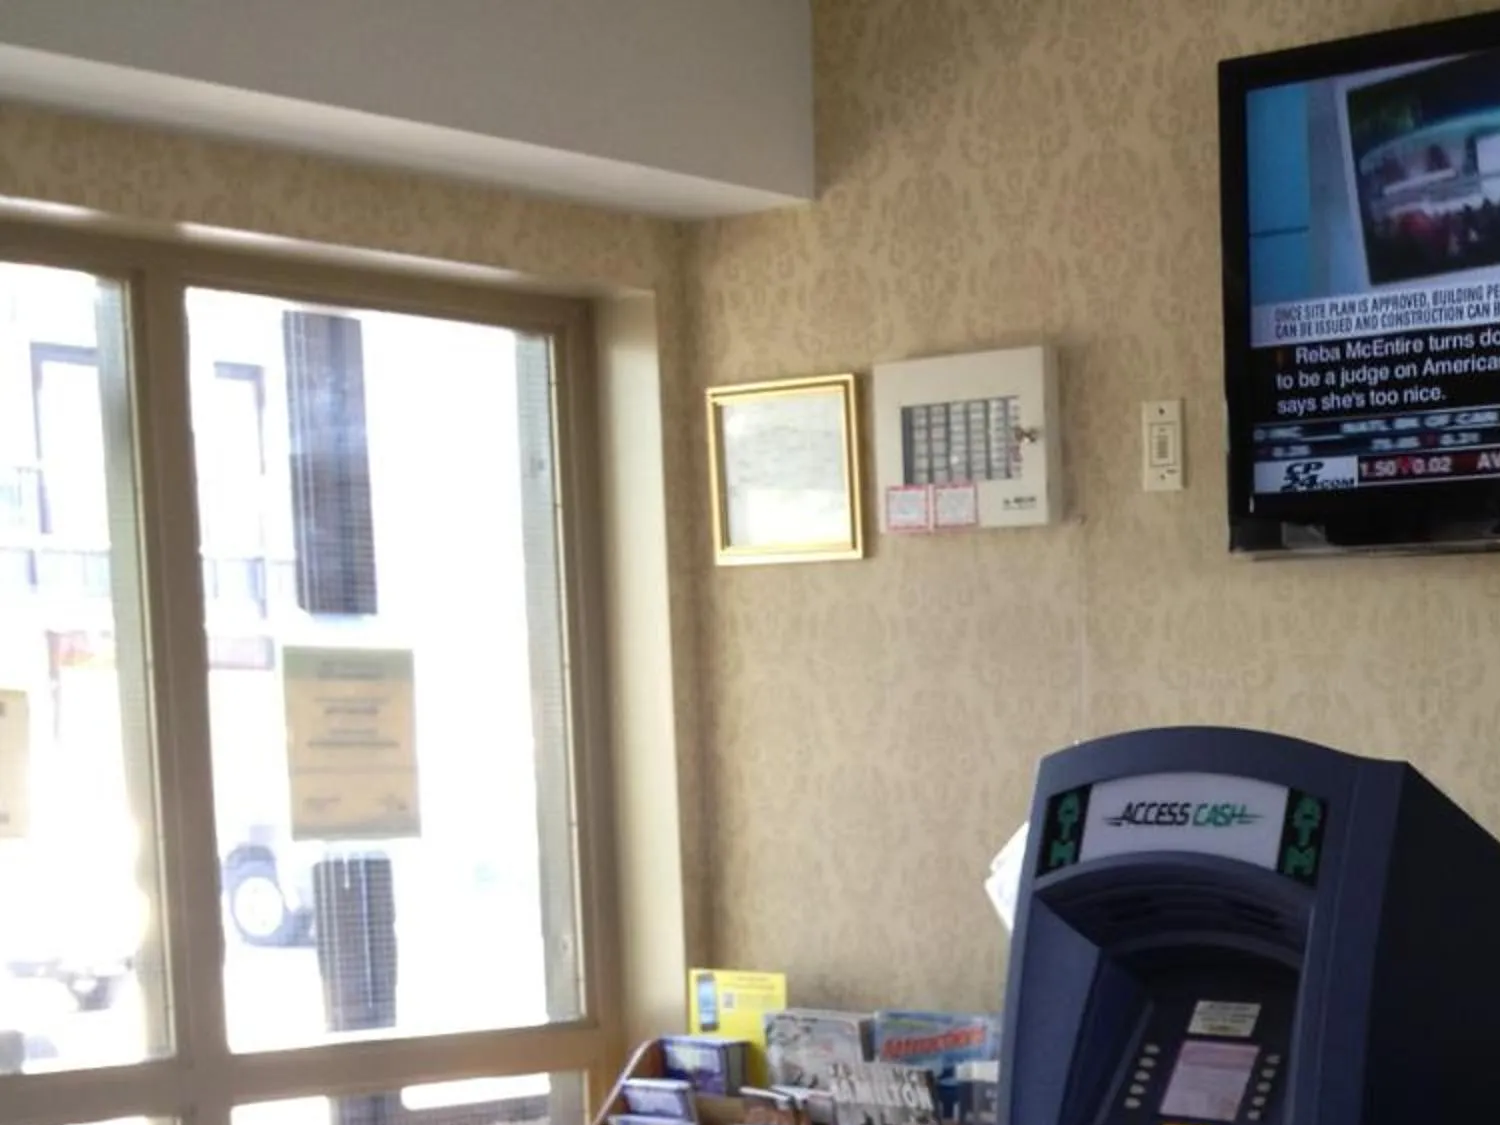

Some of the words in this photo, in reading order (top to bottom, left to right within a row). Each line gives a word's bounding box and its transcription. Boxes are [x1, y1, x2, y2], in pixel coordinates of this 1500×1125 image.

[1304, 302, 1326, 319] SITE
[1329, 299, 1356, 318] PLAN
[1358, 298, 1370, 314] IS
[1432, 285, 1484, 306] BUILDING
[1275, 321, 1297, 338] CAN
[1300, 320, 1313, 336] BE
[1315, 316, 1353, 335] ISSUED
[1355, 313, 1379, 330] AND
[1380, 304, 1464, 328] CONSTRUCTION
[1467, 302, 1491, 320] CAN
[1295, 344, 1341, 365] Reba
[1345, 337, 1424, 361] McEntire
[1429, 335, 1475, 351] turns
[1276, 373, 1294, 390] to
[1298, 370, 1321, 388] be
[1325, 371, 1336, 386] a
[1340, 365, 1390, 388] judge
[1394, 363, 1418, 380] on
[1277, 396, 1317, 417] says
[1321, 391, 1365, 411] she's
[1369, 388, 1399, 406] too
[1403, 384, 1446, 403] nice.
[1411, 456, 1452, 475] 0.02
[1117, 802, 1192, 827] ACCESS
[1192, 803, 1250, 827] CASH
